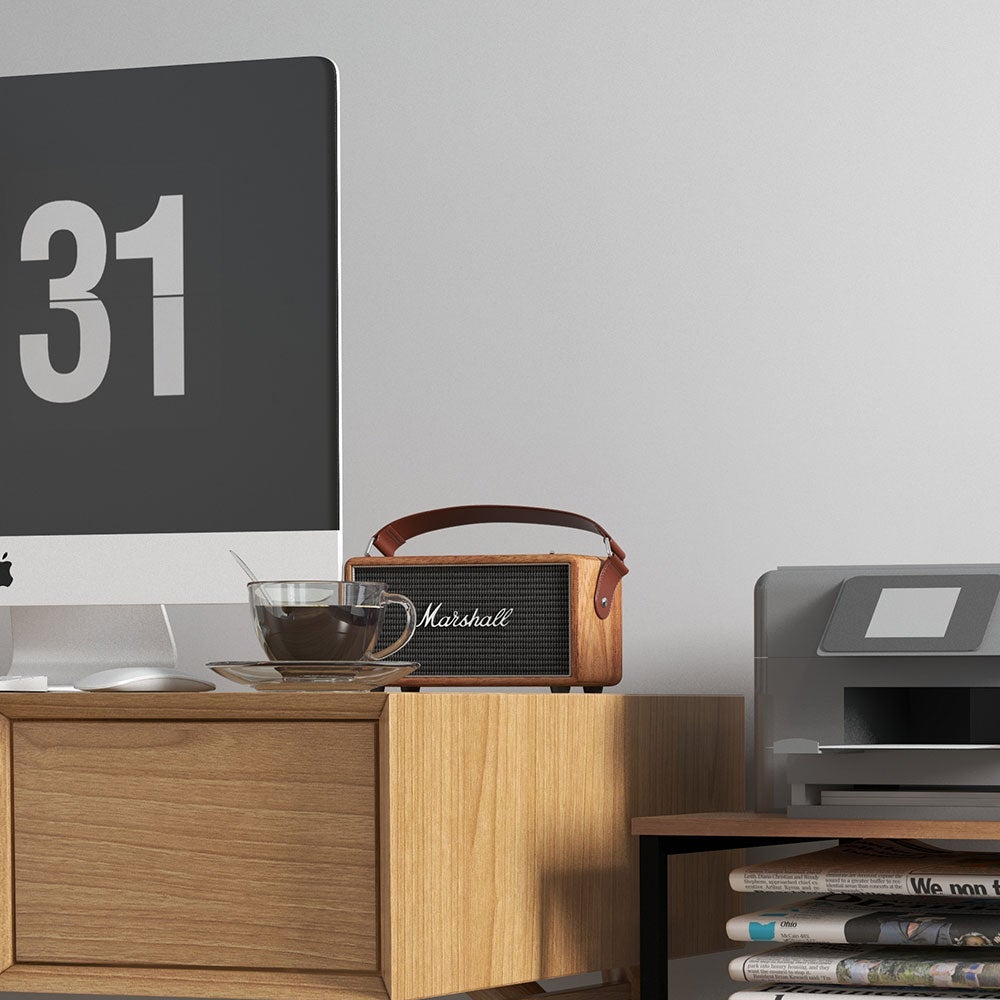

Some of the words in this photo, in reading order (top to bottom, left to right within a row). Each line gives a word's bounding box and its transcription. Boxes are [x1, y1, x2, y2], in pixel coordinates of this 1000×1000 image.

[20, 194, 185, 403] 31
[416, 602, 514, 627] Marshall
[910, 878, 943, 895] We
